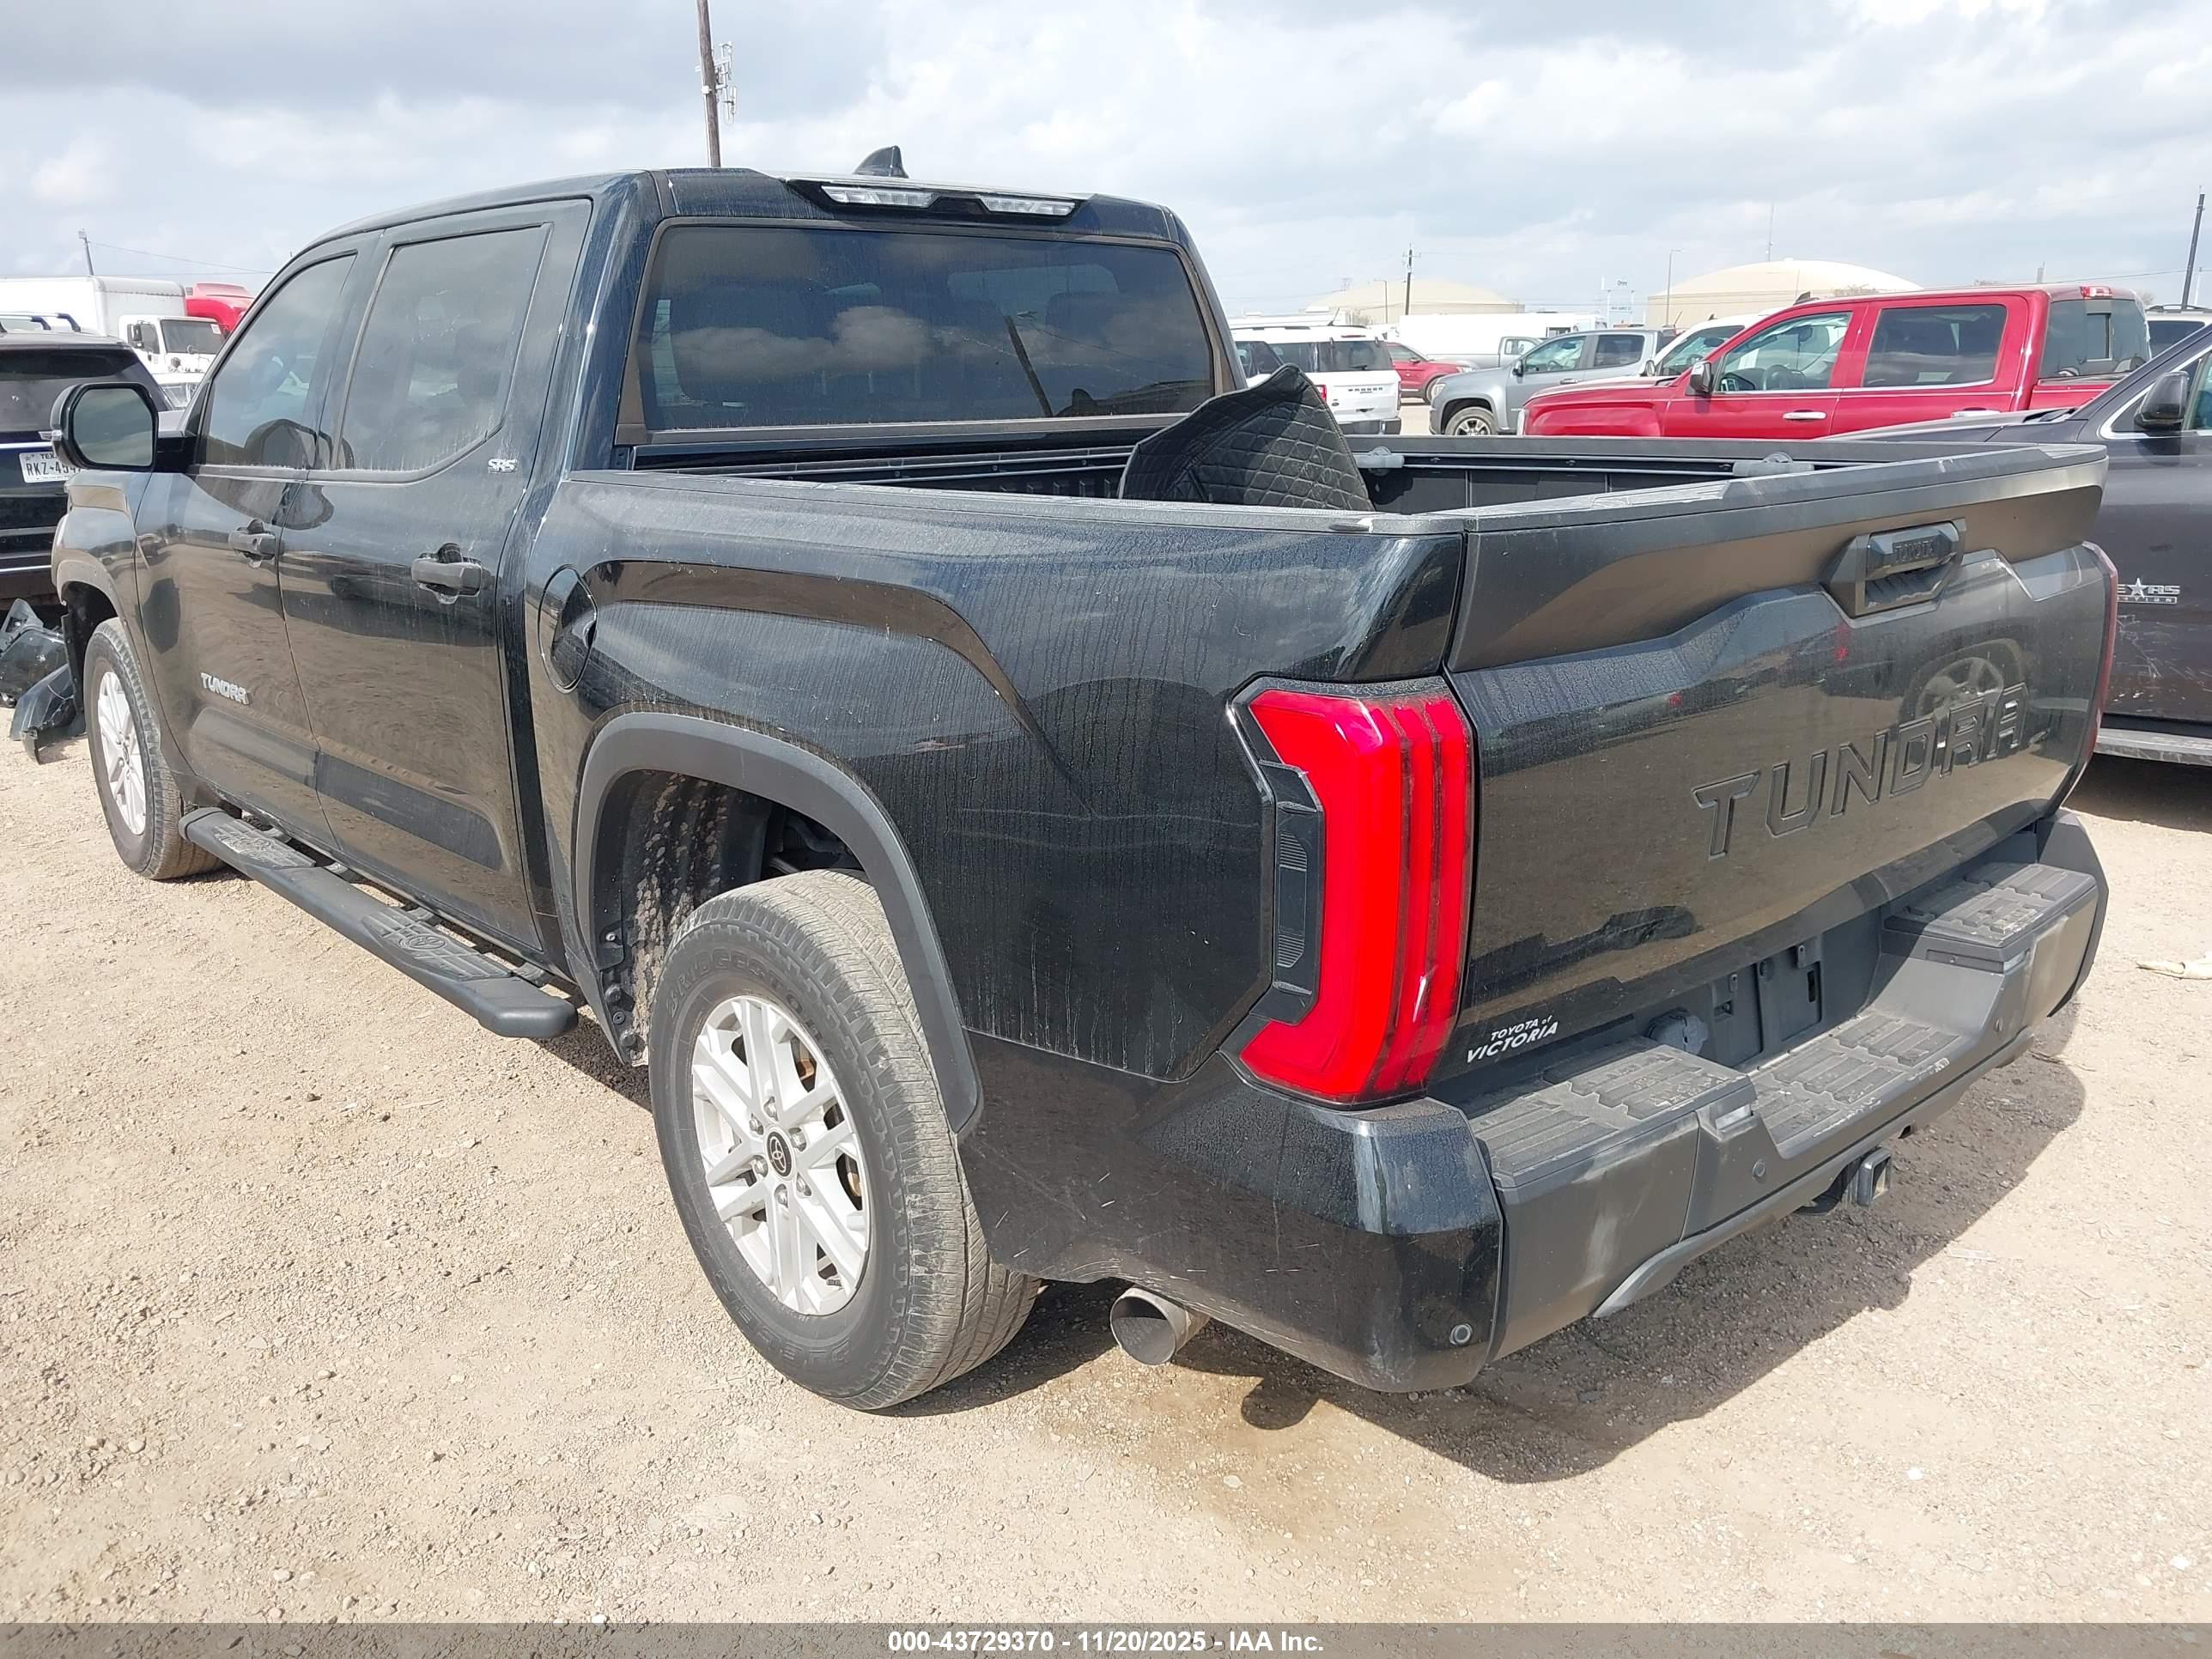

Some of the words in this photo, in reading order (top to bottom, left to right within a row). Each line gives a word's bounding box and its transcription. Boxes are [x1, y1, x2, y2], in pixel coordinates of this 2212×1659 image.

[26, 462, 49, 476] RKZ
[488, 459, 518, 473] SR5
[1894, 540, 1936, 563] TOYOTA
[200, 672, 250, 705] TUNDRA
[1691, 682, 2027, 860] TUNDRA
[1491, 1018, 1539, 1042] TOYOTA
[1541, 1014, 1553, 1024] of
[1467, 1022, 1559, 1063] VICTORIA
